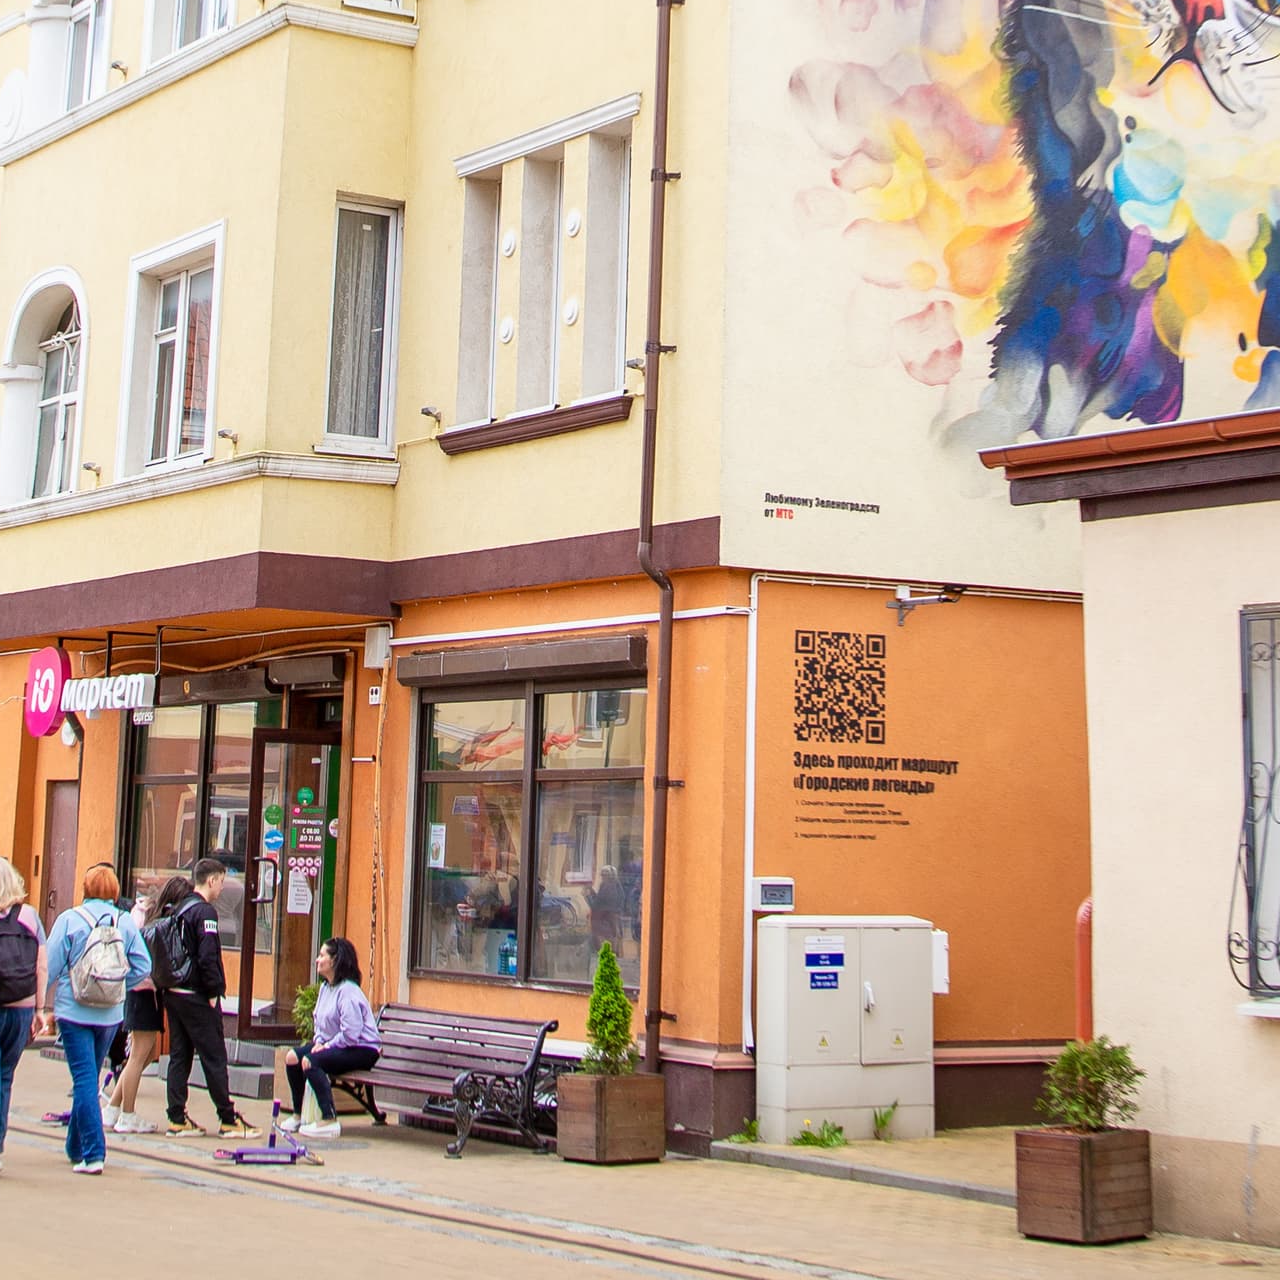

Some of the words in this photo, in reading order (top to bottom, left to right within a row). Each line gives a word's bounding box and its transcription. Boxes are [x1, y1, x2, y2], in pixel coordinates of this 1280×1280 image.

[764, 492, 814, 508] Любимому
[815, 497, 881, 514] Зеленоградску
[764, 508, 775, 519] от
[776, 508, 794, 520] МТС
[60, 673, 147, 719] маркет
[133, 710, 154, 725] express
[793, 750, 835, 771] Здесь
[837, 753, 899, 772] проходит
[902, 757, 959, 776] маршрут
[793, 773, 870, 792] «Городские
[872, 777, 936, 795] легенды»
